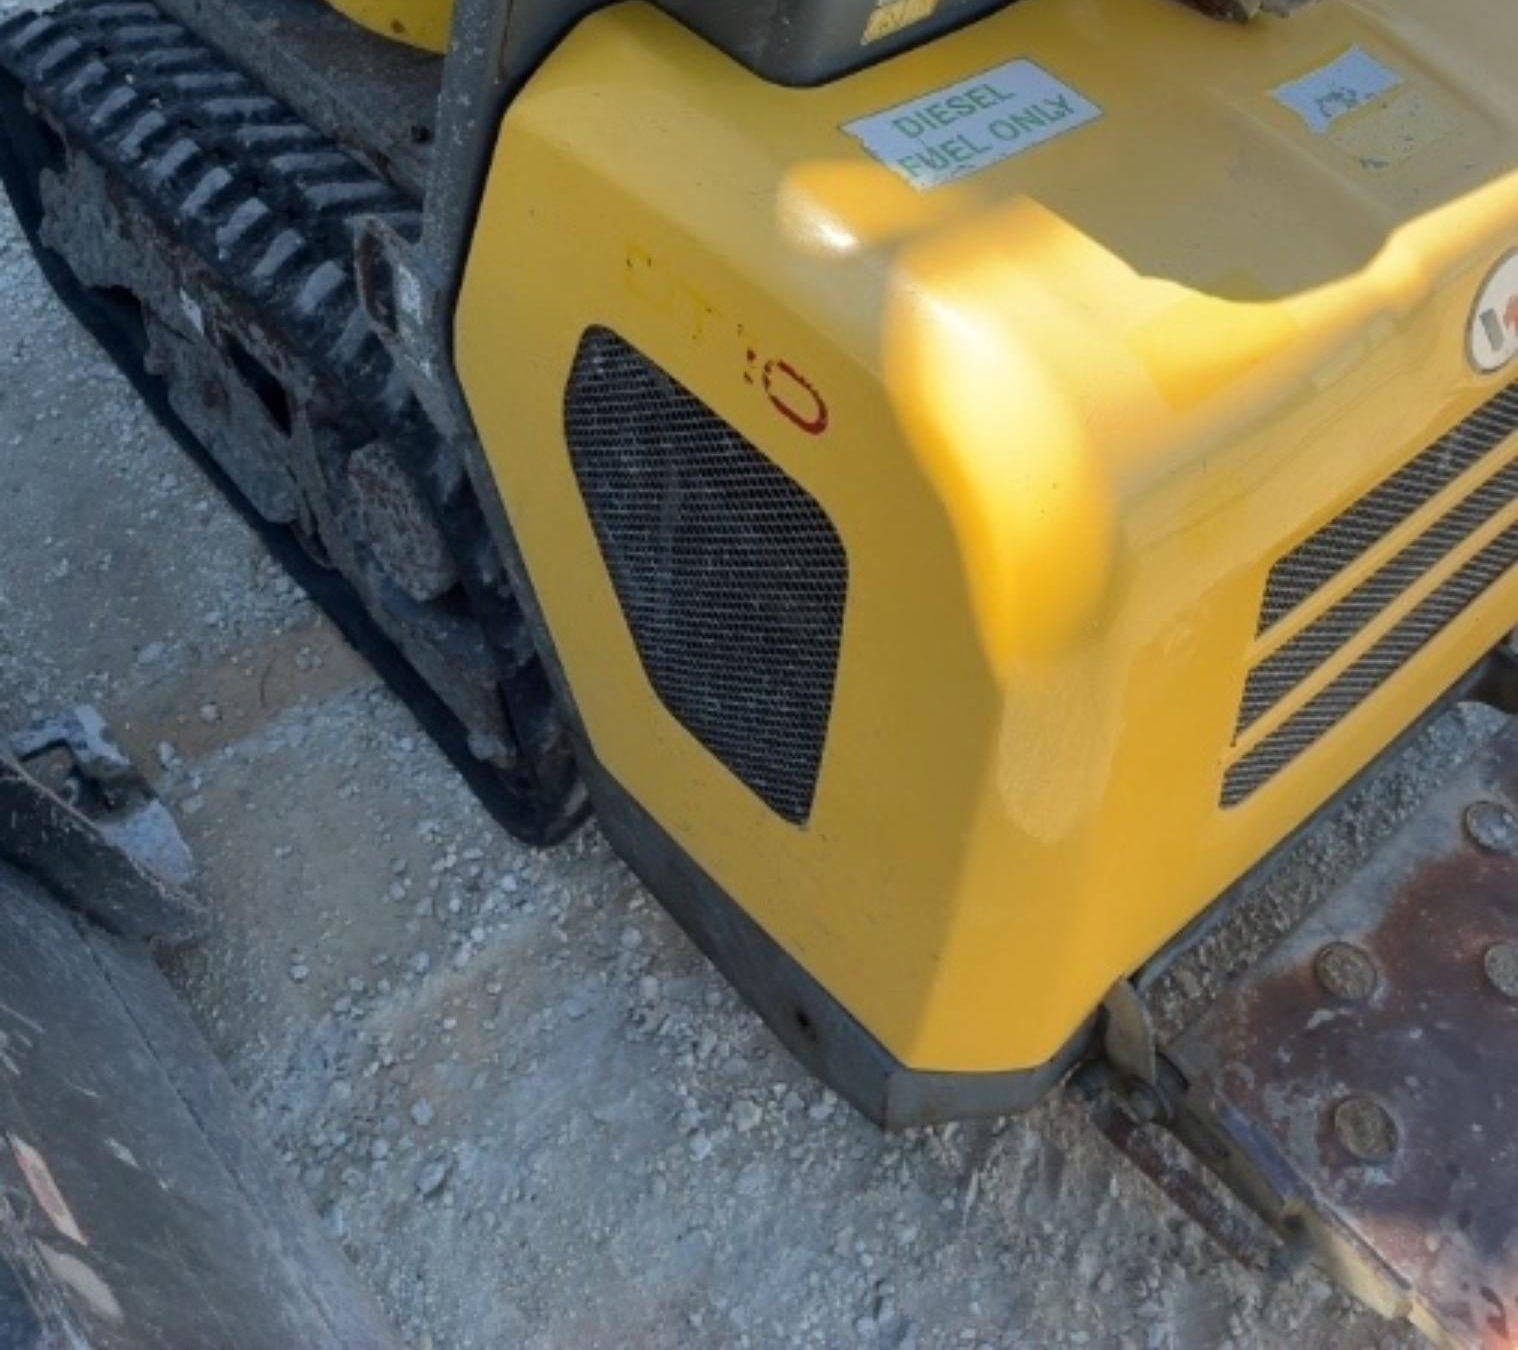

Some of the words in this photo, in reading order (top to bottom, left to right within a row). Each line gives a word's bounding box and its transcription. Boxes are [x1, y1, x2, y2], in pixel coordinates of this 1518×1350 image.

[891, 83, 1016, 139] DIESEL
[897, 133, 993, 179] FUEL
[987, 93, 1077, 142] ONLY
